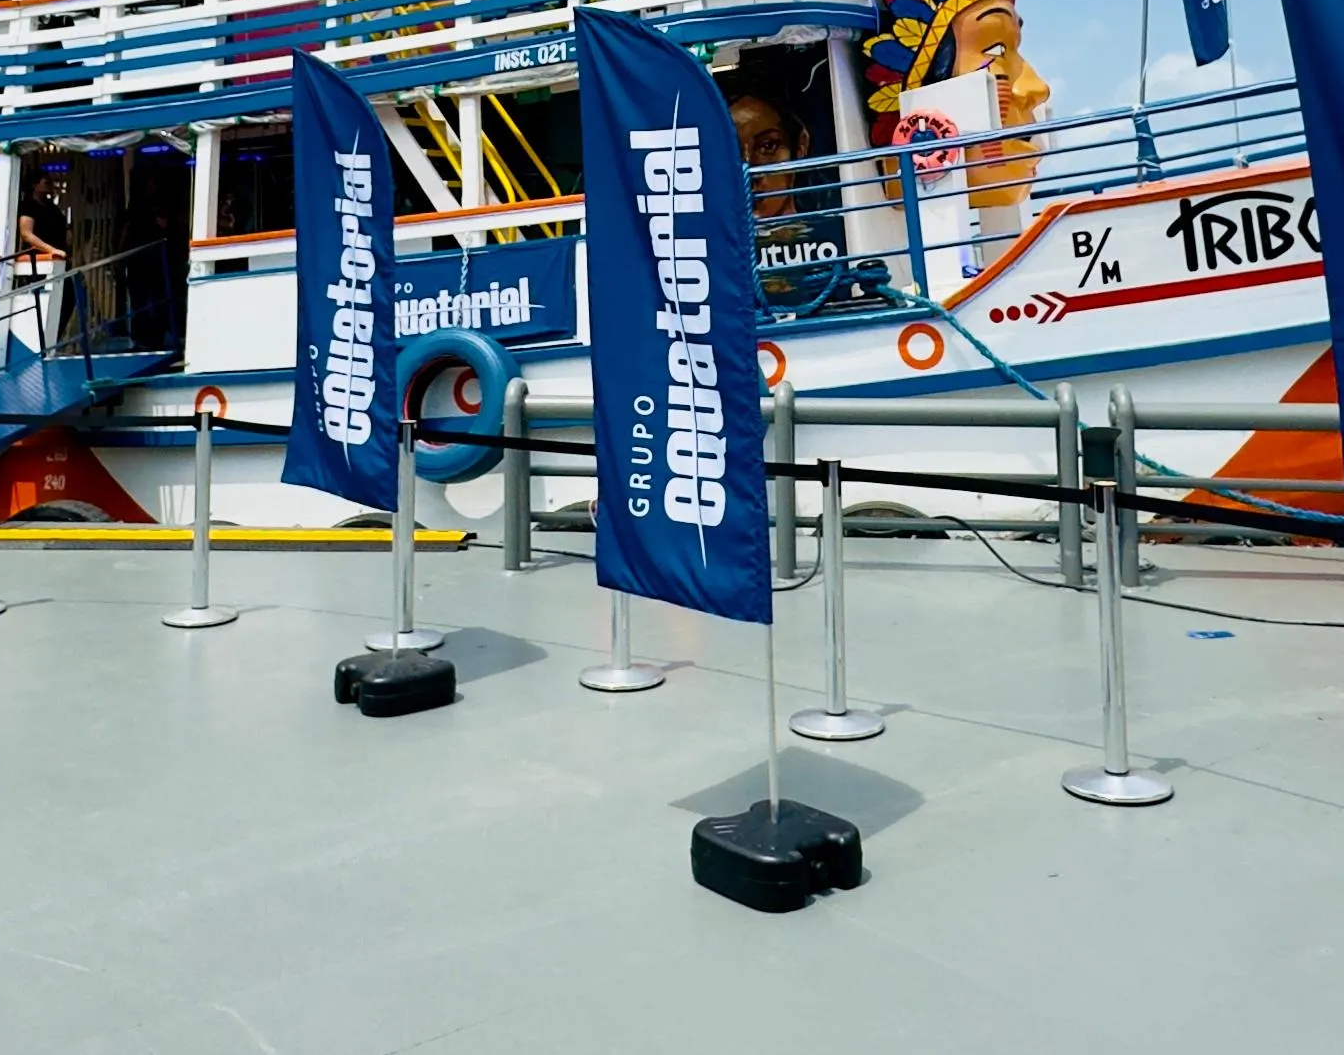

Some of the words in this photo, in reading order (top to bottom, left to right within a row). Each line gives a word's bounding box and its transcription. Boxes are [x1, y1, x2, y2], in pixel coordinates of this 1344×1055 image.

[494, 49, 535, 72] INSC.
[322, 151, 376, 446] equatorial
[629, 126, 726, 528] equatorial
[628, 394, 656, 518] GRUPO
